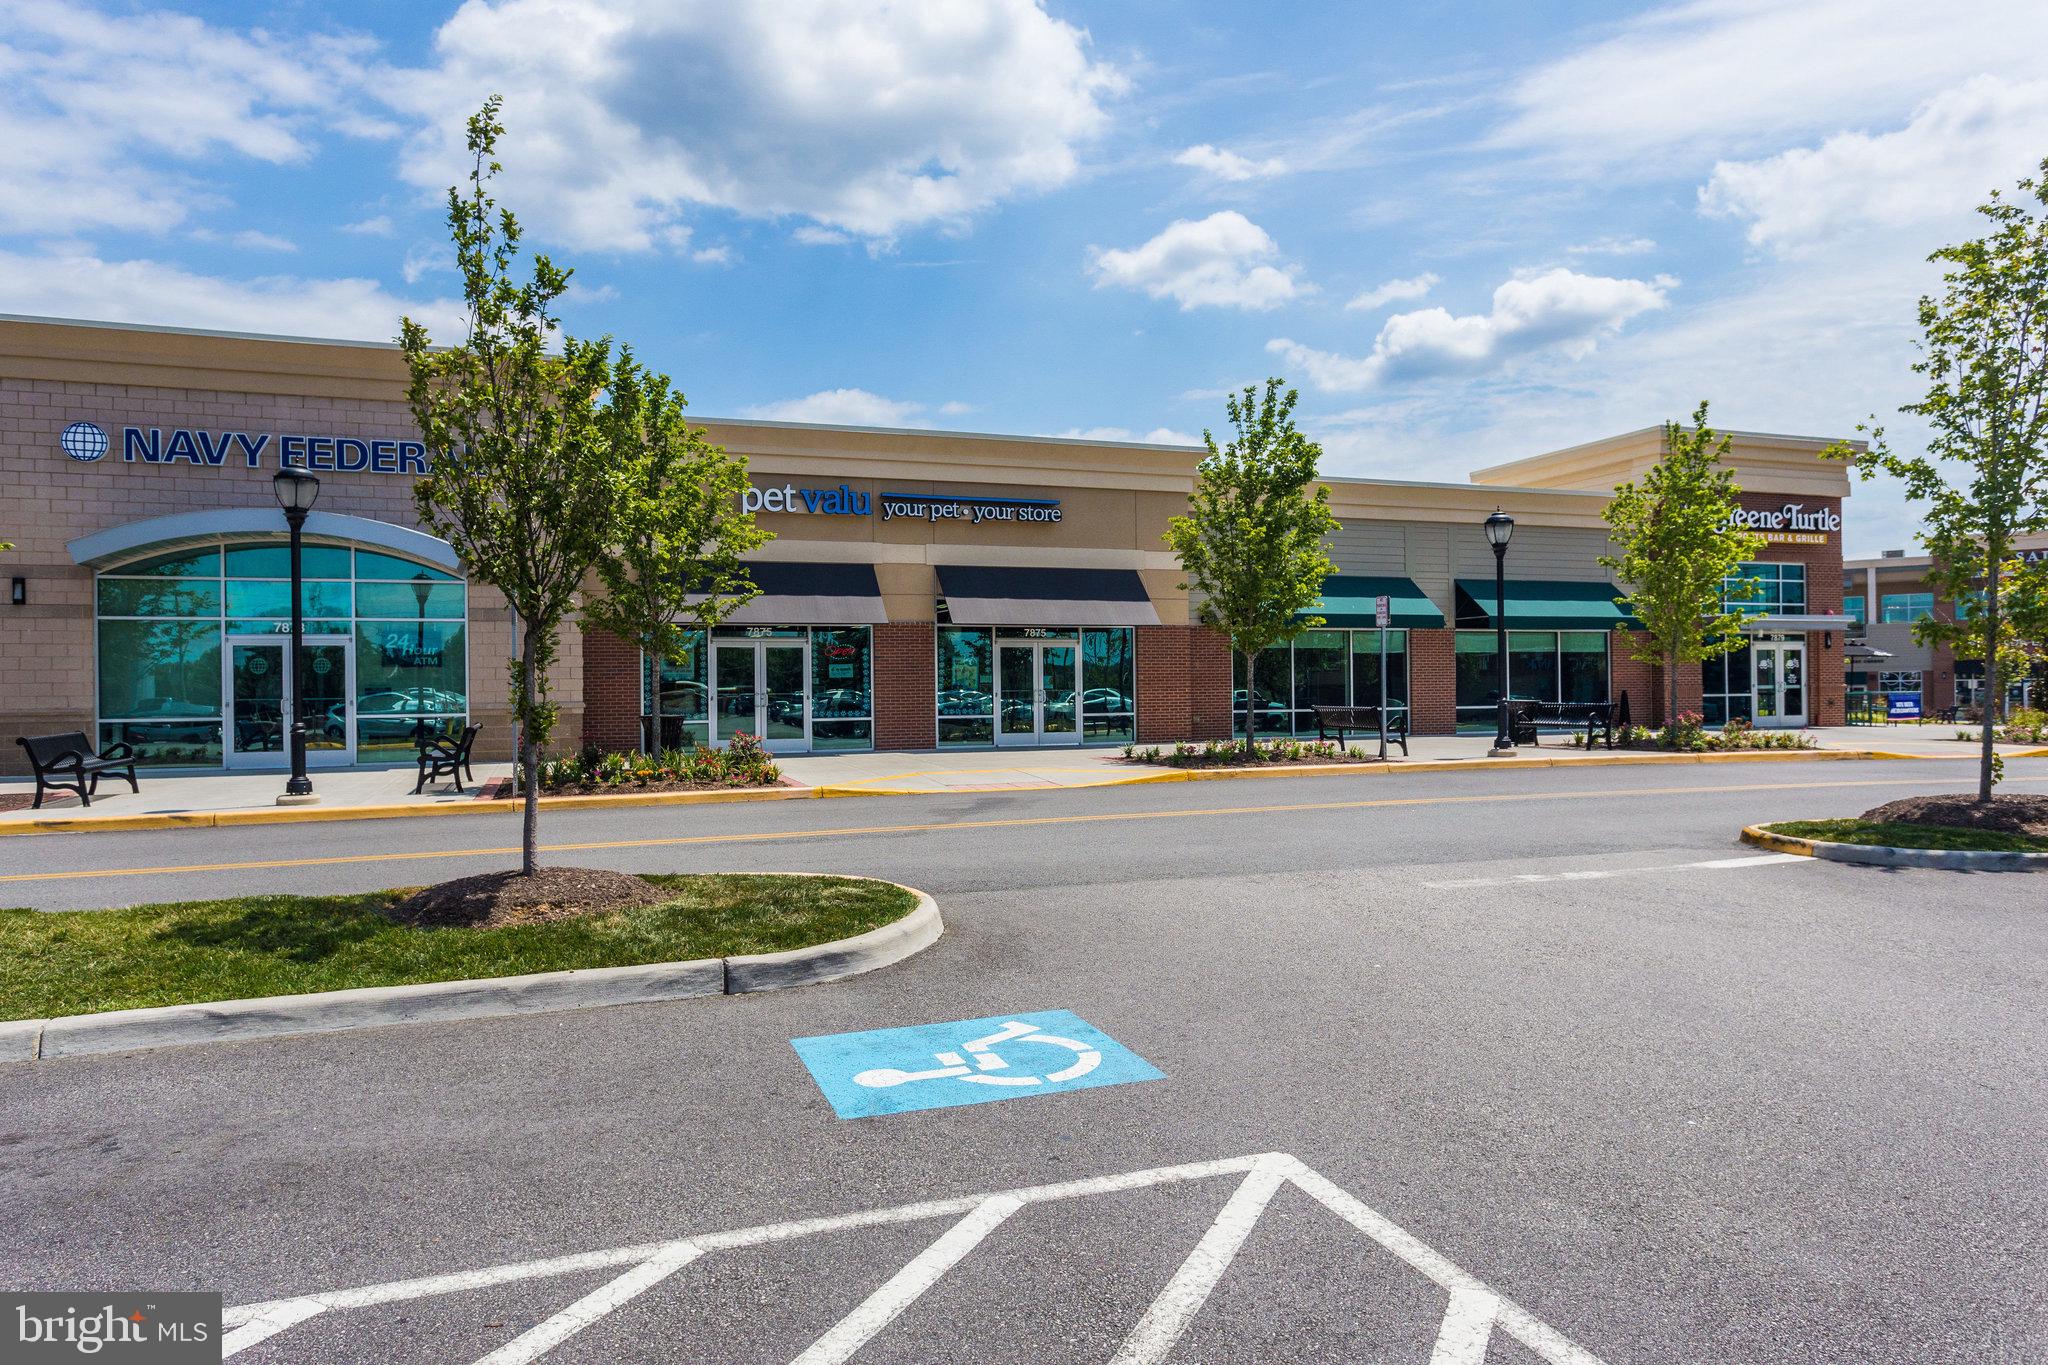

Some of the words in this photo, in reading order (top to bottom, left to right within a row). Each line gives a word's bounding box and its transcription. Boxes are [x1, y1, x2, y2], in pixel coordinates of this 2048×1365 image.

[123, 427, 272, 468] NAVY
[280, 435, 488, 477] FEDER
[742, 484, 797, 515] pet
[799, 484, 872, 515] valu
[883, 500, 926, 521] your
[929, 503, 960, 522] pet
[973, 505, 1016, 524] your
[1018, 509, 1062, 522] store
[1782, 503, 1841, 532] Turtle
[1768, 533, 1785, 543] BAR
[1788, 535, 1793, 543] &
[1796, 534, 1825, 543] GRILLE
[746, 627, 773, 637] 7875
[1024, 628, 1047, 637] 7875
[385, 633, 409, 649] 24
[413, 656, 438, 665] ATM
